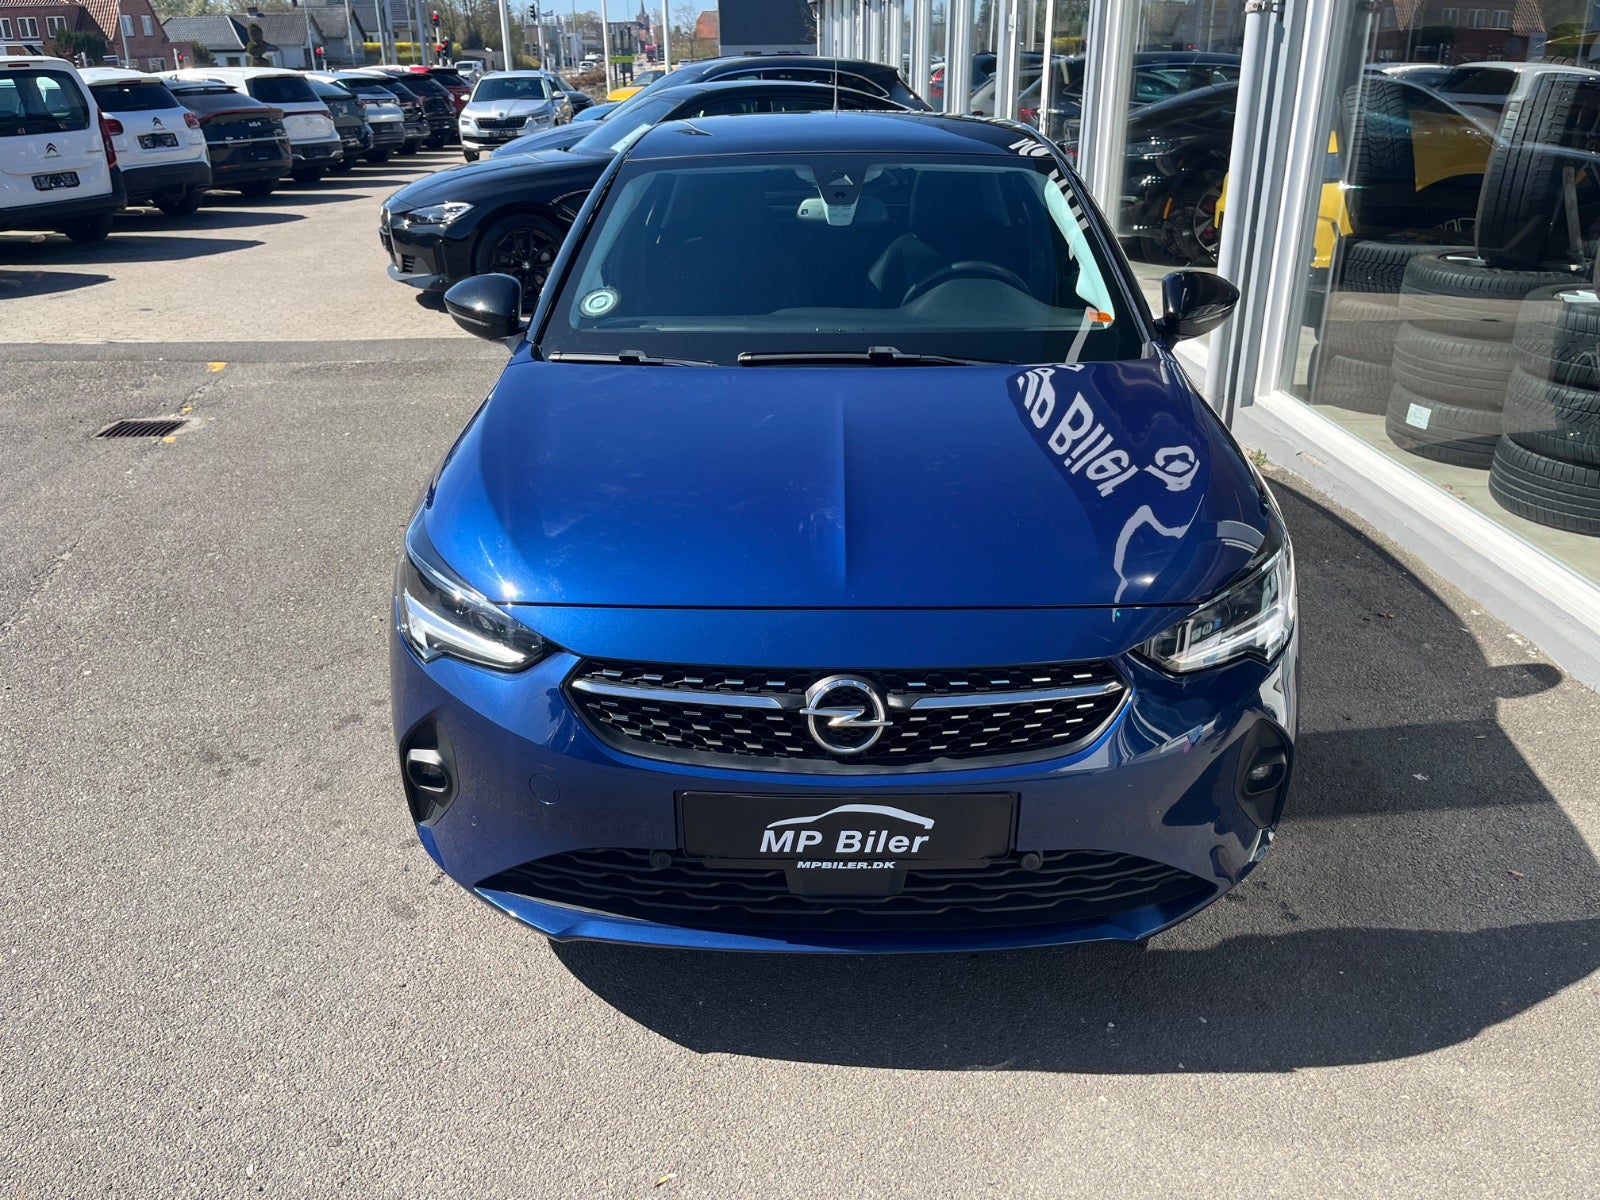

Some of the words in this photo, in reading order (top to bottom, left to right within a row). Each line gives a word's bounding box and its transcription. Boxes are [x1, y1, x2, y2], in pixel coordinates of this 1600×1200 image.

[760, 829, 823, 853] MP
[836, 829, 930, 853] Biler
[797, 861, 896, 870] MPBILER.DK
